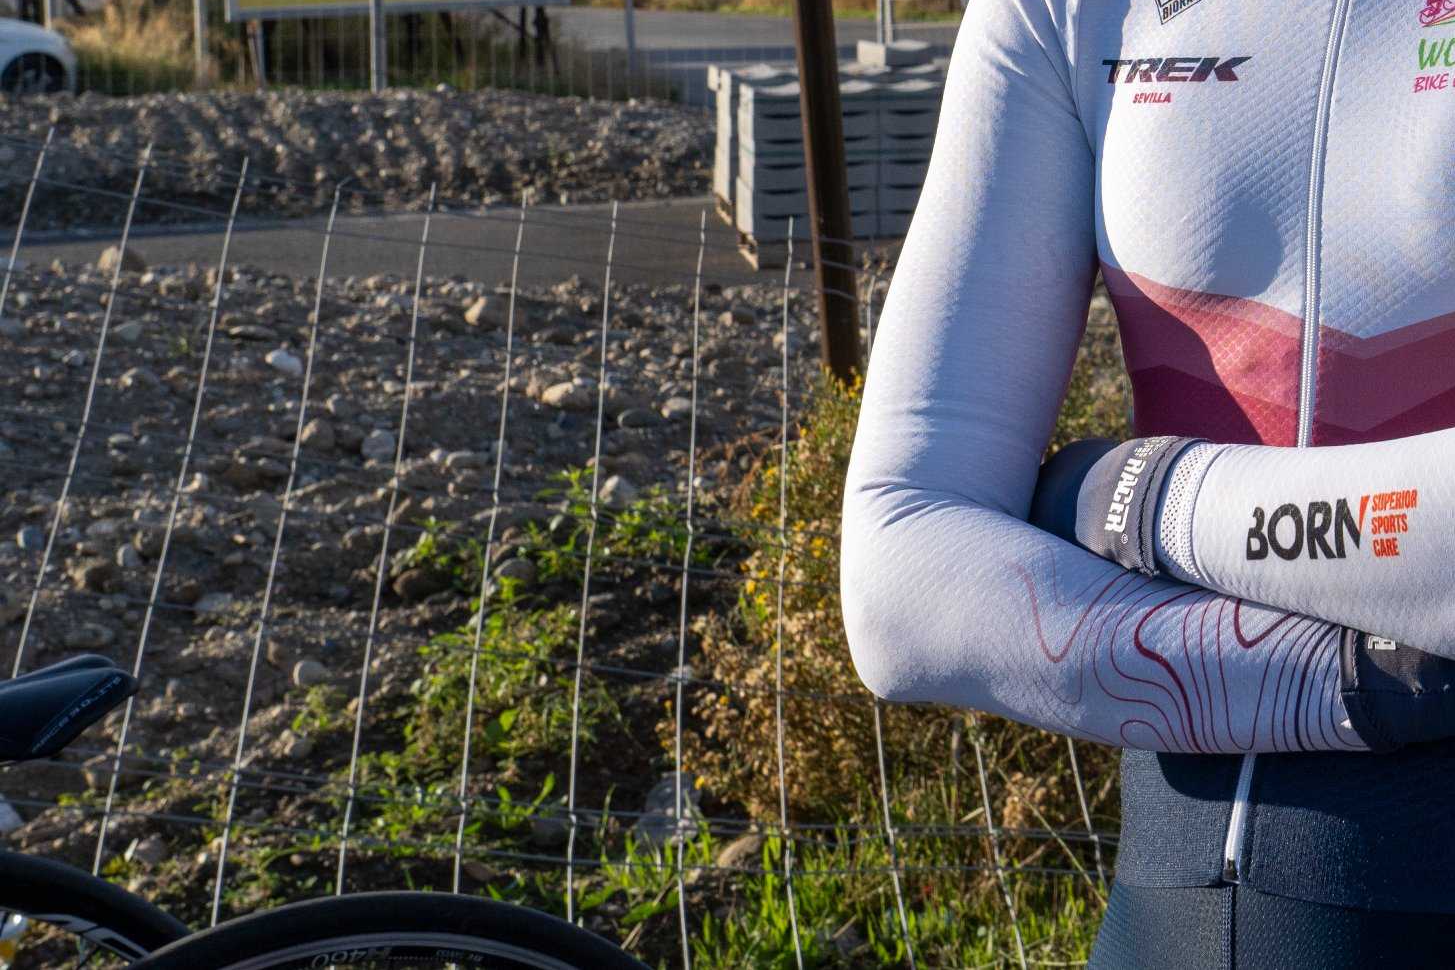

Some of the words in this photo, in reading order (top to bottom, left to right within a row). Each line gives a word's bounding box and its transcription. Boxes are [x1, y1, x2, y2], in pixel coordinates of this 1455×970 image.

[1102, 51, 1253, 84] TREK
[1413, 72, 1449, 94] BIKE
[1132, 92, 1172, 104] SEVILLA
[1371, 489, 1418, 513] SUPERIOR
[1246, 495, 1370, 562] BORN
[1371, 514, 1409, 535] SPORTS
[1372, 538, 1400, 558] CARE
